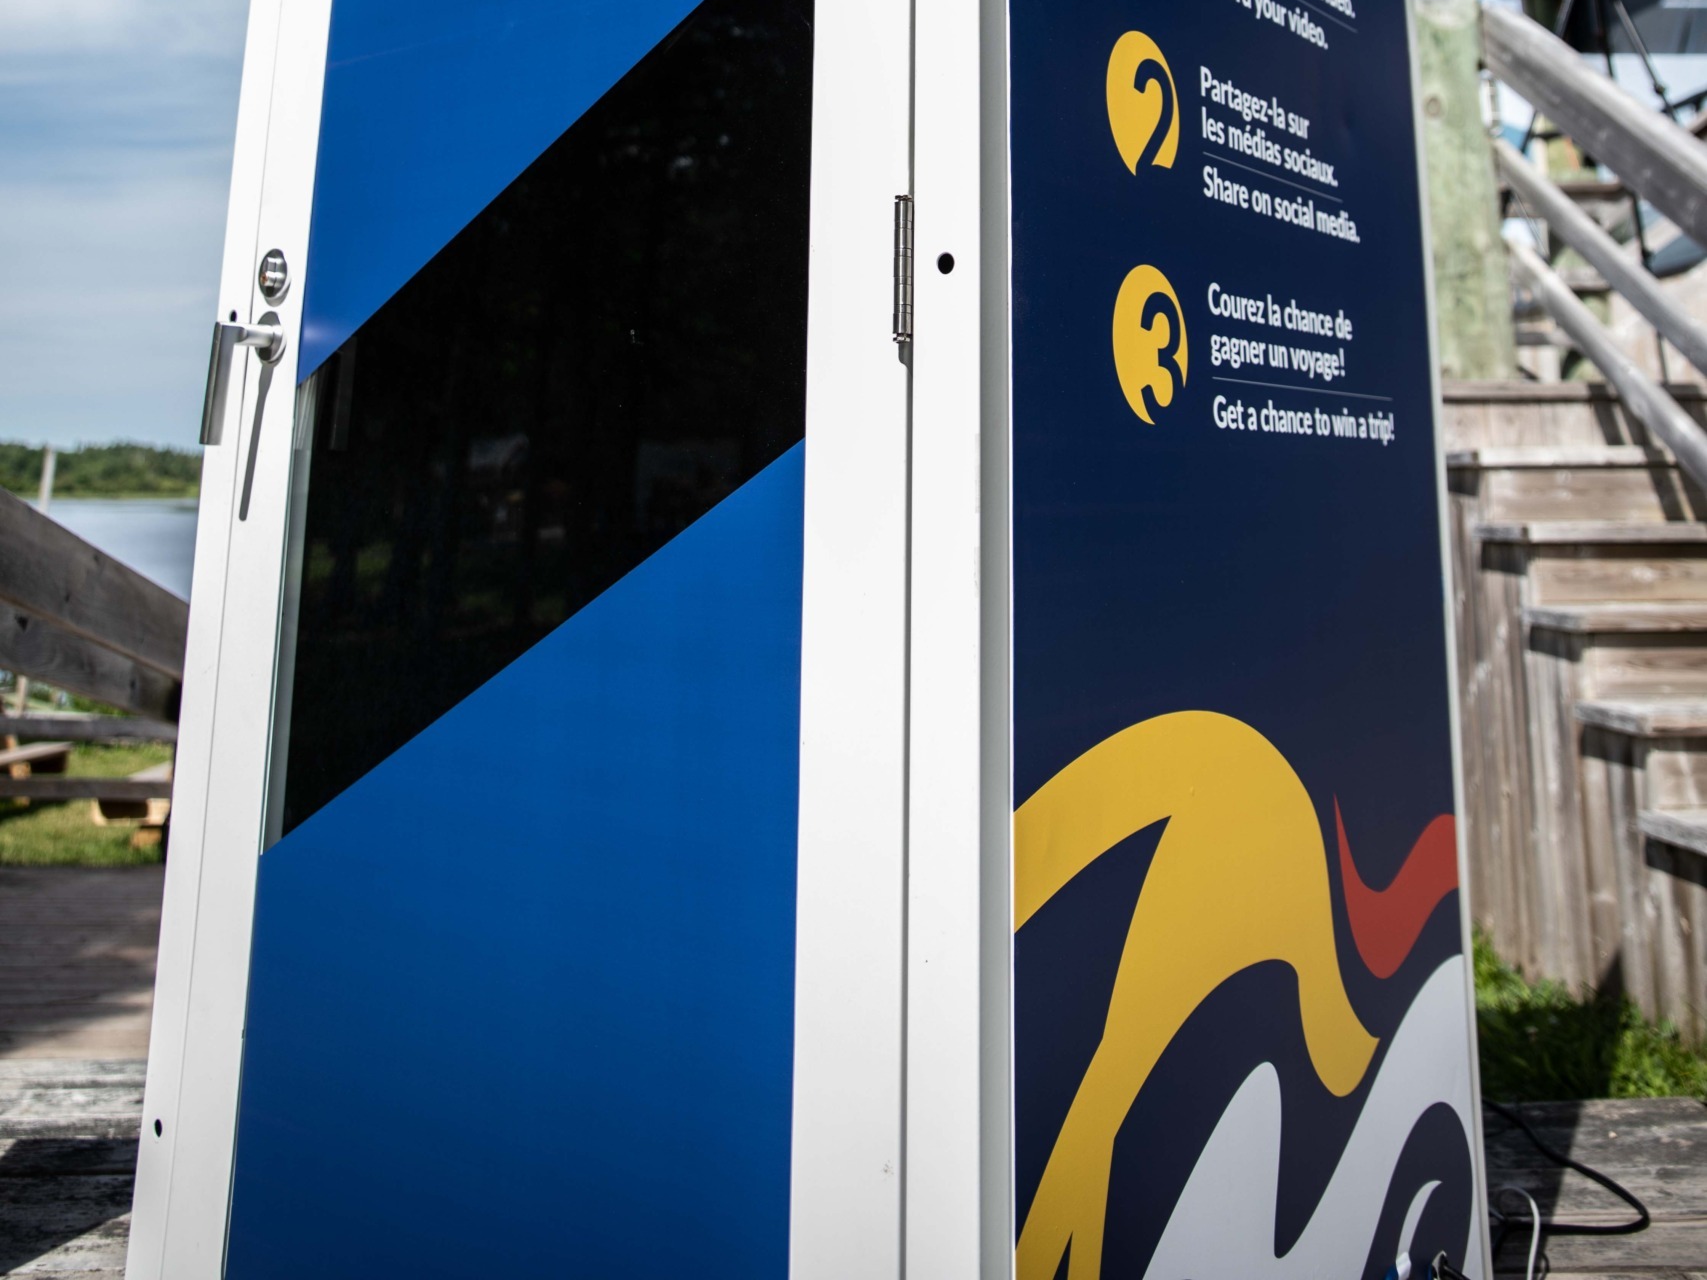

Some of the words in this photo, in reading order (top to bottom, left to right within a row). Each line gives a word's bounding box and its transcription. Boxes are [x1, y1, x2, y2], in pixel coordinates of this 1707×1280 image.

[1288, 8, 1328, 49] video.
[1134, 59, 1174, 176] 2
[1200, 66, 1286, 130] Partagez-la
[1288, 111, 1309, 140] sur
[1202, 107, 1225, 143] les
[1229, 121, 1281, 166] médias
[1284, 140, 1338, 187] sociaux.
[1203, 166, 1248, 209] Share
[1252, 190, 1272, 216] on
[1275, 194, 1314, 229] social
[1317, 211, 1360, 243] media.
[1208, 282, 1264, 325] Courez
[1267, 294, 1281, 328] la
[1285, 297, 1333, 337] chance
[1335, 310, 1352, 340] de
[1141, 291, 1184, 424] 3
[1211, 334, 1266, 368] gagner
[1269, 343, 1288, 367] un
[1291, 348, 1345, 381] voyage!
[1213, 395, 1244, 430] Get
[1248, 407, 1257, 431] a
[1260, 399, 1313, 436] chance
[1315, 408, 1330, 436] to
[1333, 409, 1357, 438] win
[1359, 417, 1367, 439] a
[1368, 413, 1395, 446] trip!
